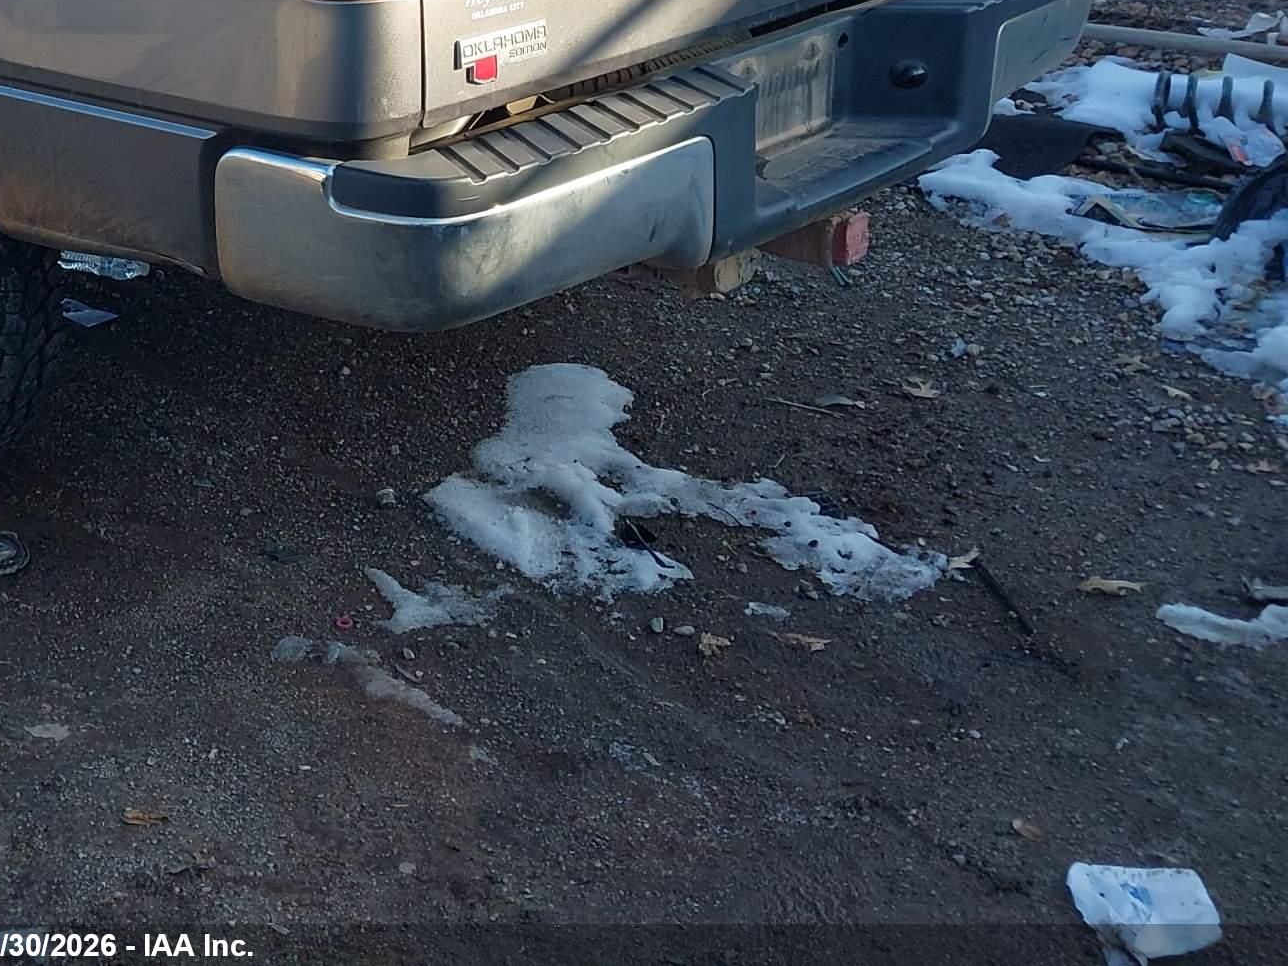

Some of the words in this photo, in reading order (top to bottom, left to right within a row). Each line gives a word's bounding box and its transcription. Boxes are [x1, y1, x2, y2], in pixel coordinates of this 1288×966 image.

[509, 1, 525, 12] CITY
[463, 25, 546, 58] OKLAHOMA
[509, 41, 547, 58] EDITION
